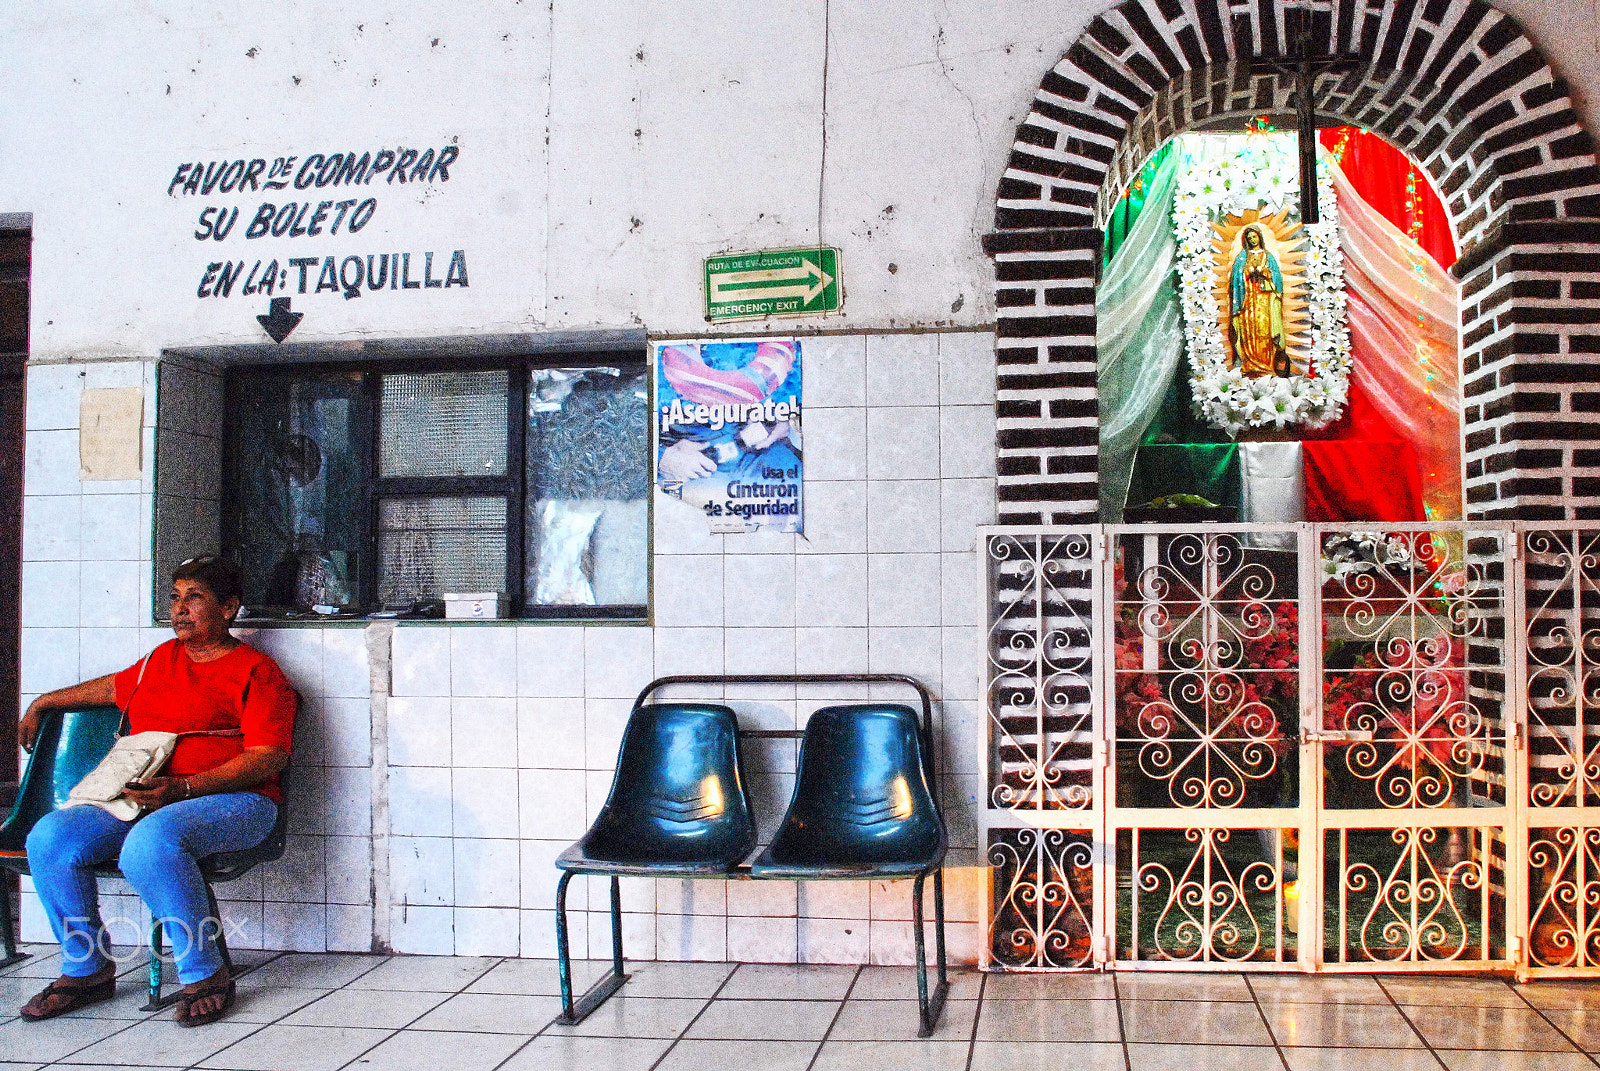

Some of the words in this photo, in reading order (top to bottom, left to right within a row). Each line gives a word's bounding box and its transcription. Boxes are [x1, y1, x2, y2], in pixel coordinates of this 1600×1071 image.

[167, 158, 266, 197] FAVOR
[269, 156, 298, 181] DE
[294, 146, 460, 191] COMPRAR
[194, 205, 239, 242] SU
[245, 197, 378, 240] BOLETO
[197, 260, 244, 299] EN
[288, 249, 470, 300] TAQUILLA
[708, 261, 730, 271] RUTA
[732, 260, 744, 269] DE
[710, 302, 774, 316] EMERGENCY
[776, 301, 799, 310] EXIT
[761, 466, 784, 479] Usa
[787, 464, 798, 479] el
[726, 477, 799, 499] Cinturón
[703, 500, 722, 517] de
[725, 498, 799, 520] Seguridad
